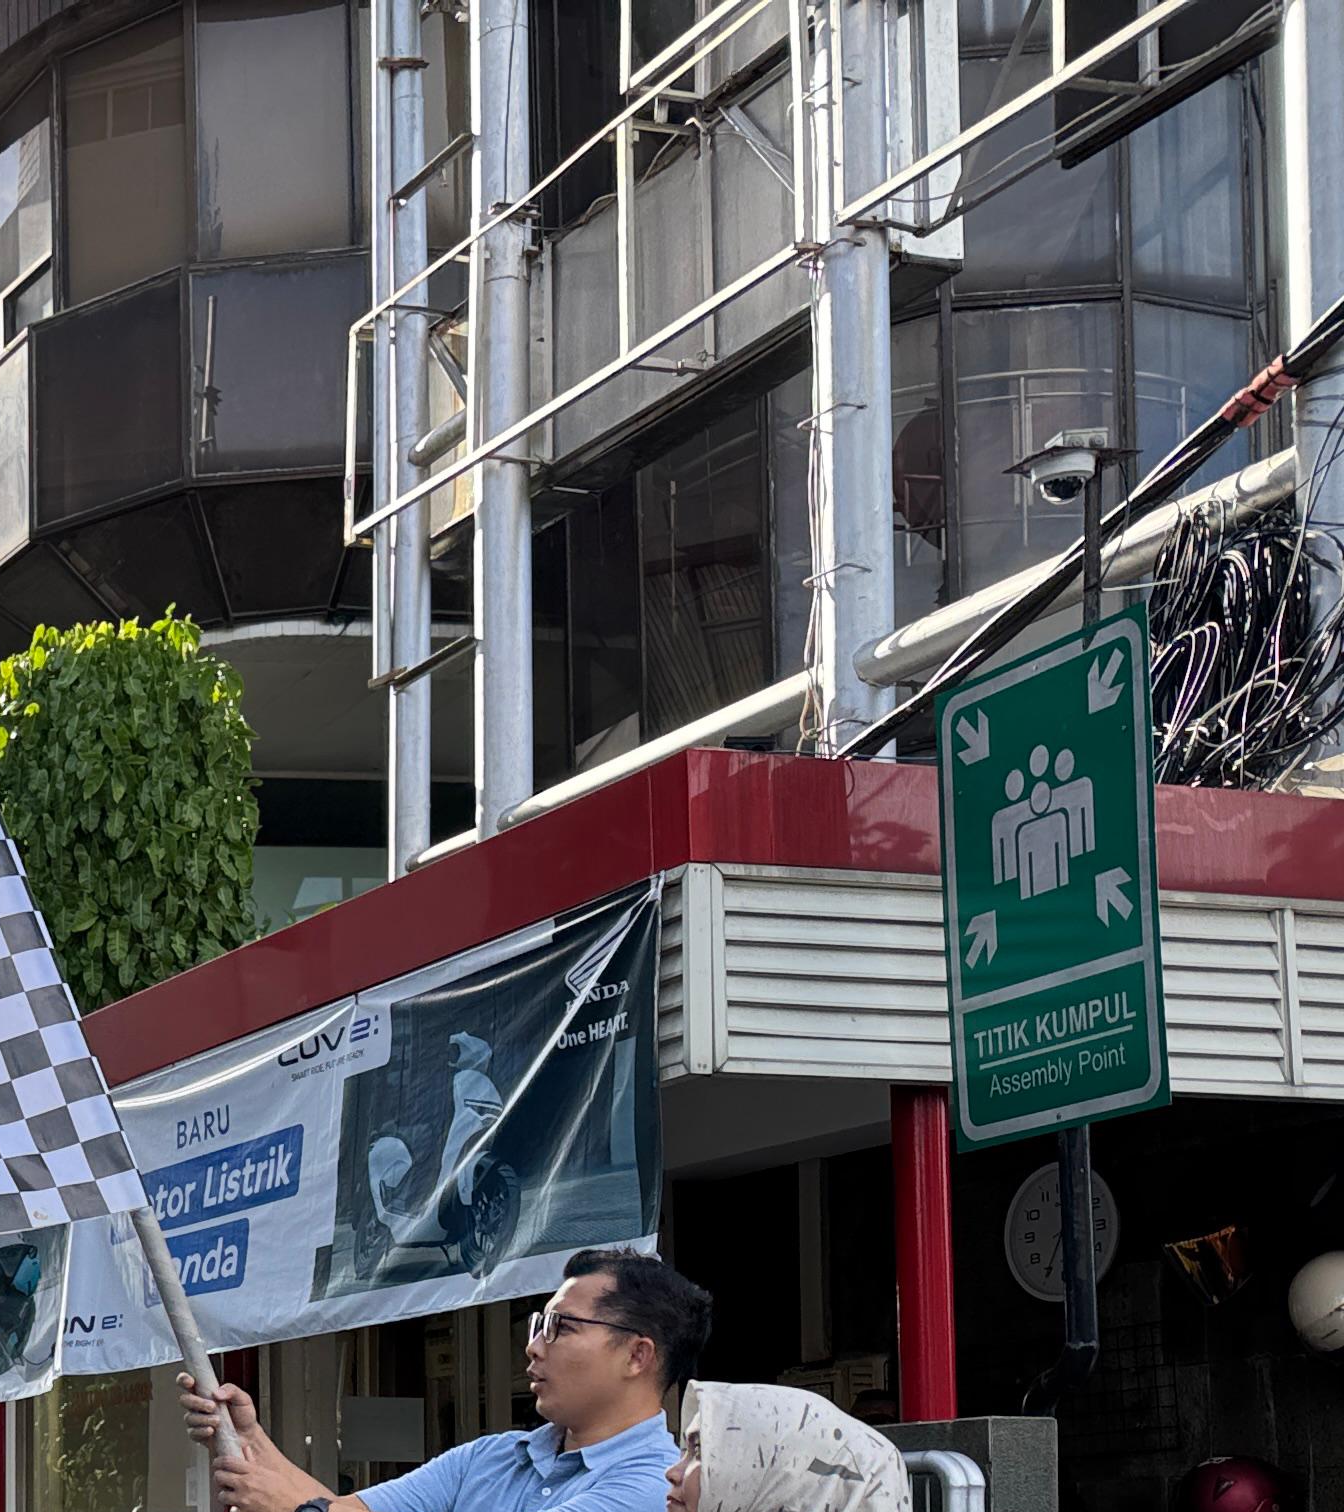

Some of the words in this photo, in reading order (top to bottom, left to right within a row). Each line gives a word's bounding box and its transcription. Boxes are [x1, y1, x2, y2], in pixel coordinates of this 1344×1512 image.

[557, 1031, 587, 1049] One
[973, 1017, 1030, 1060] TITIK
[1035, 990, 1137, 1049] KUMPUL
[989, 1054, 1073, 1099] Assembly
[1077, 1041, 1127, 1078] Point
[176, 1104, 230, 1149] BARU
[202, 1143, 293, 1208] Listrik
[1024, 1209, 1040, 1221] 10
[1024, 1231, 1035, 1243] 9
[1030, 1252, 1041, 1264] 8
